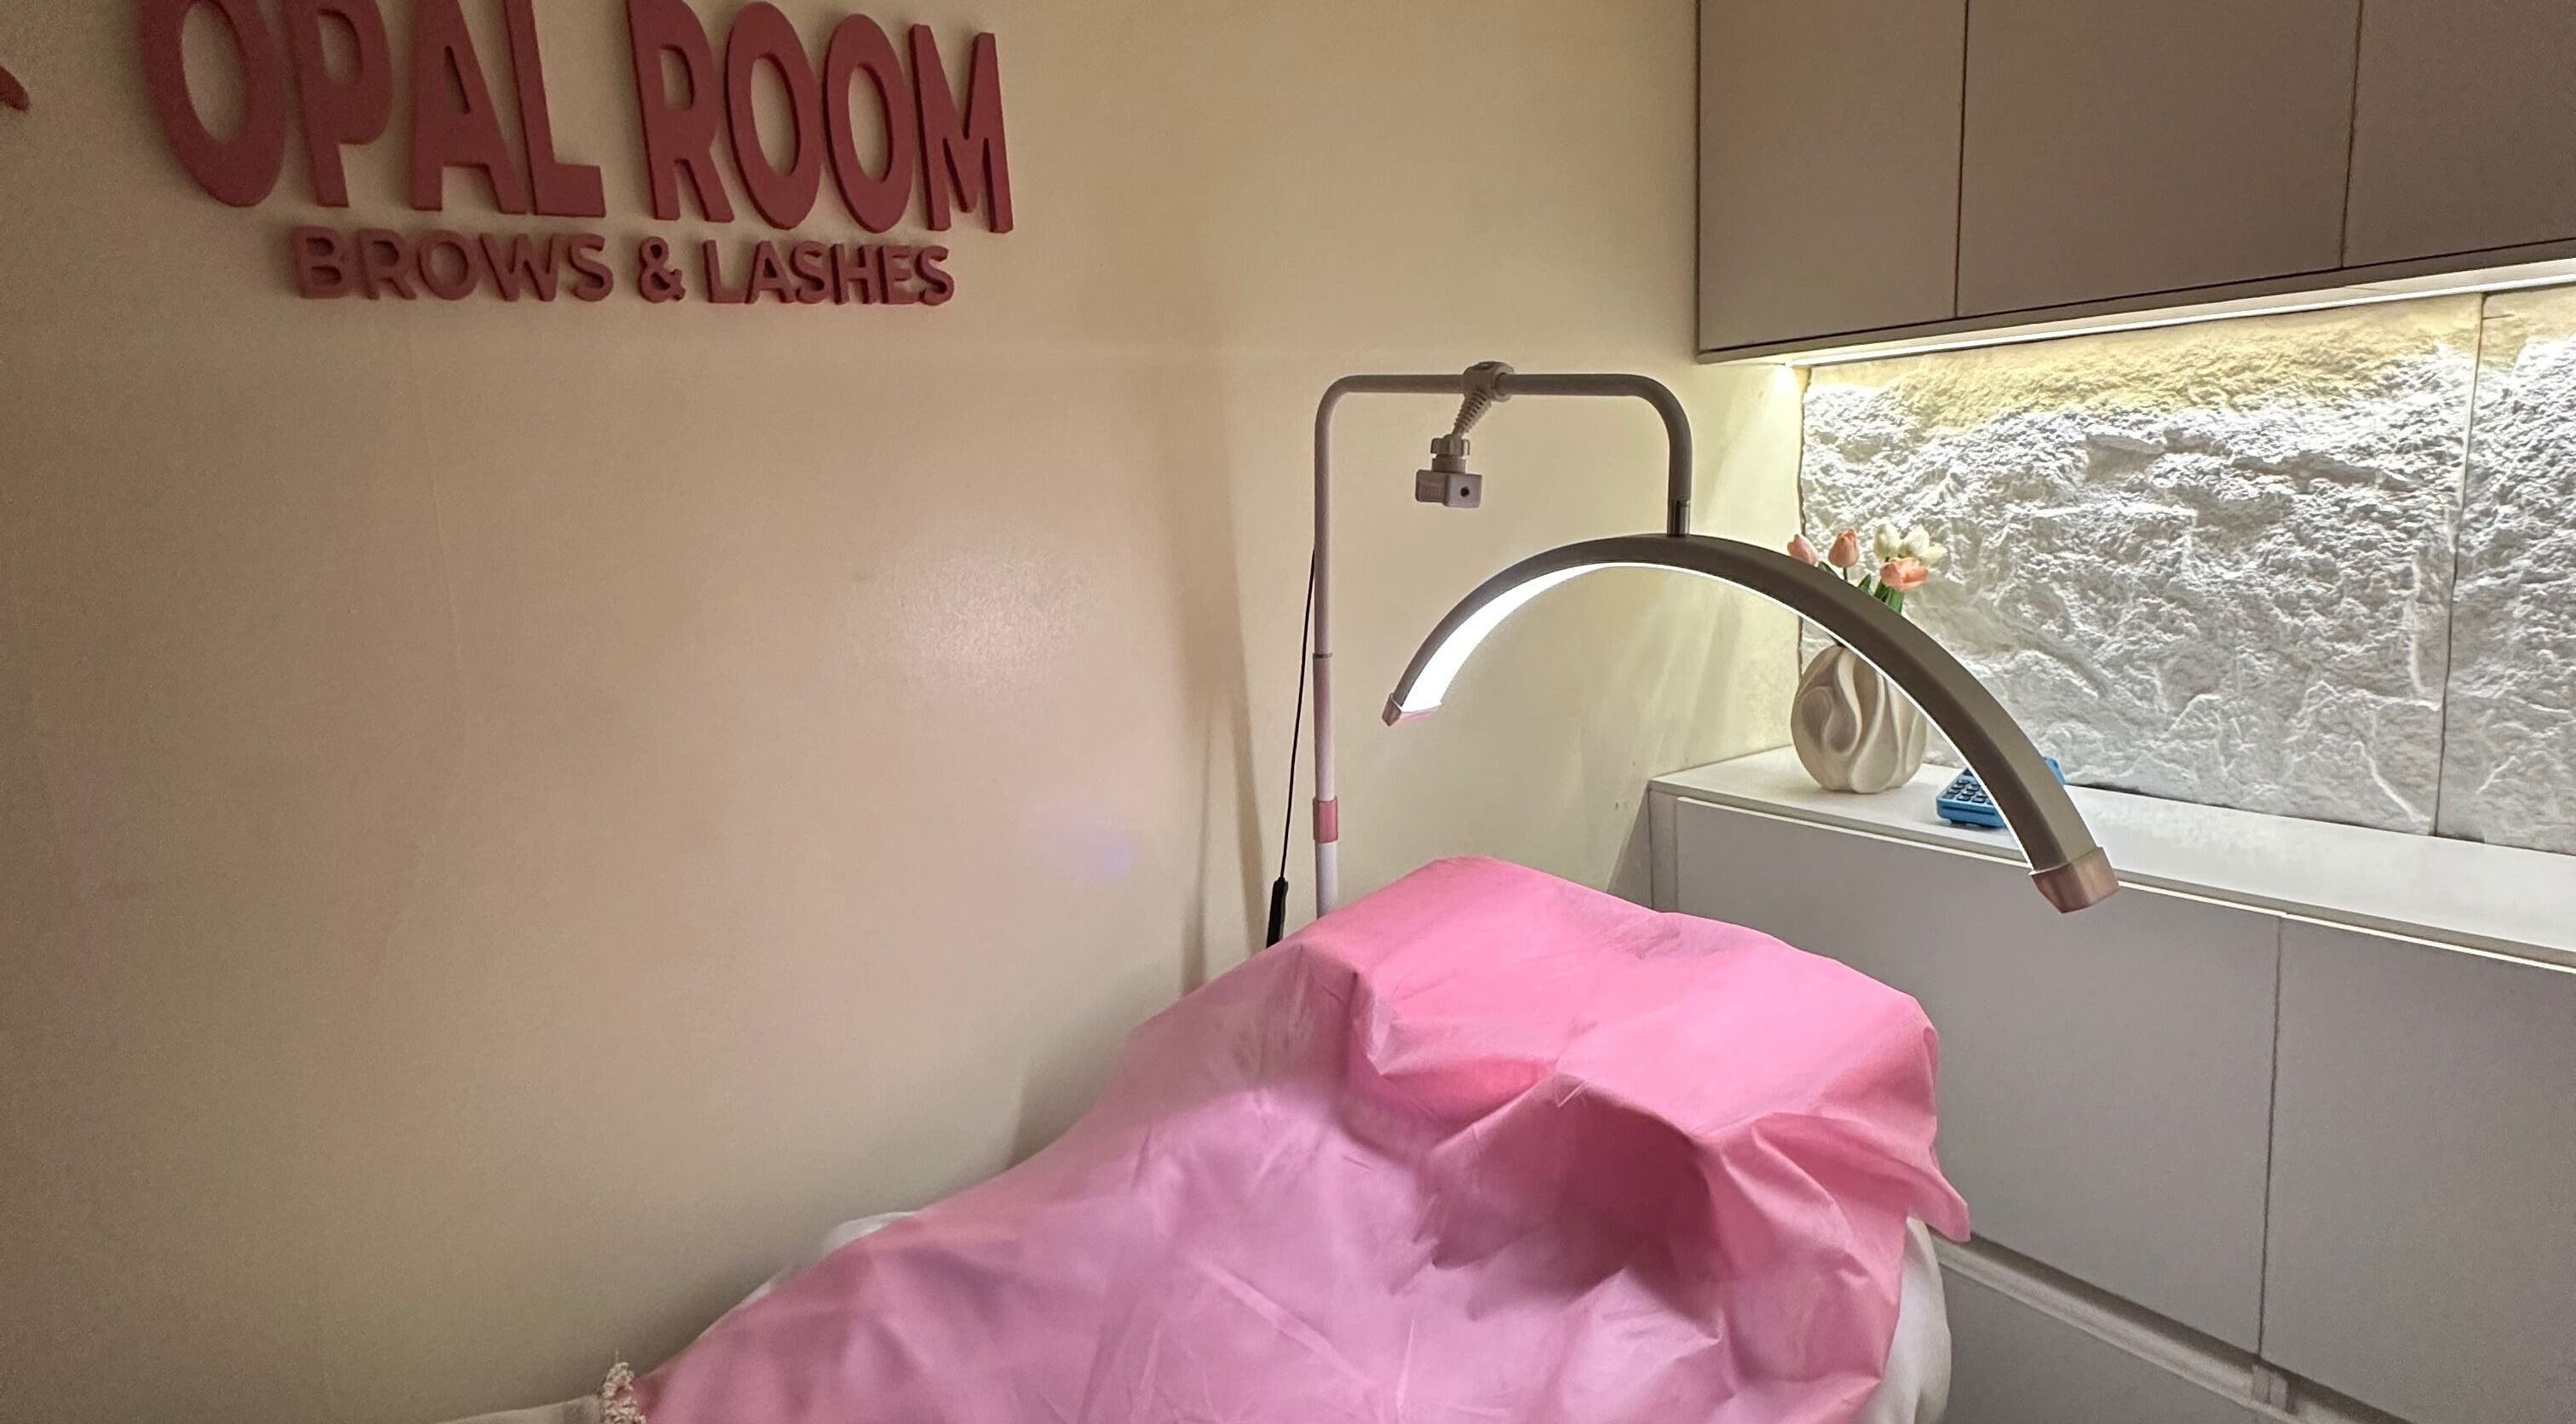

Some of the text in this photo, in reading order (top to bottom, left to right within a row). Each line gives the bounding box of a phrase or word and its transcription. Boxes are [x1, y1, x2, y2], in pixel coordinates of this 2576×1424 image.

[140, 0, 1014, 234] OPAL ROOM
[290, 225, 955, 307] BROWS & LASHES
